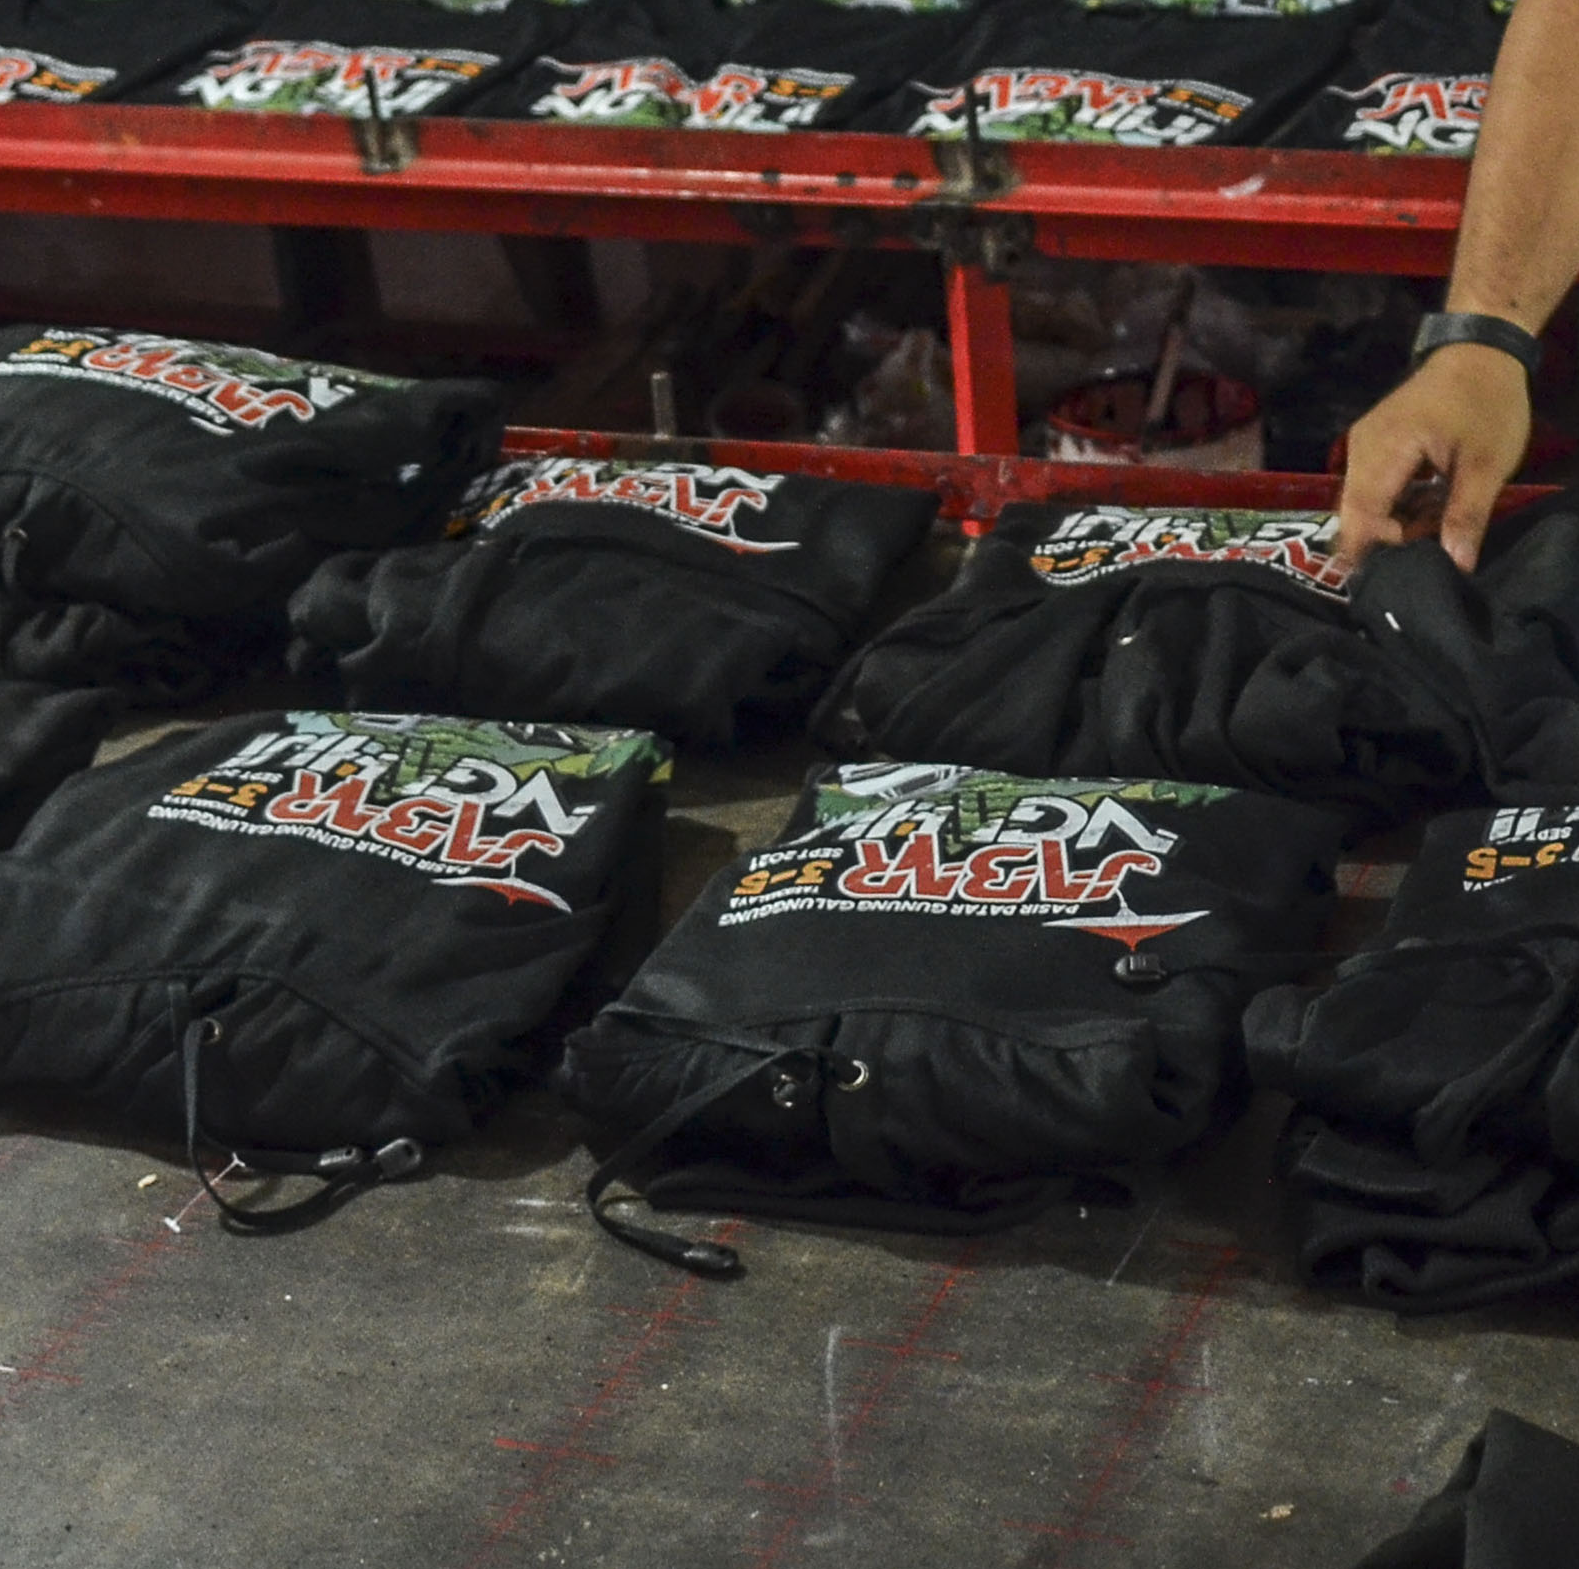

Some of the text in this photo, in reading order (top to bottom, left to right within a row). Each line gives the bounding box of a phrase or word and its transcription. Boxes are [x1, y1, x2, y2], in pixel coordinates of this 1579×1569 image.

[264, 770, 565, 870] JABAR
[273, 823, 356, 851] GUNUNG
[355, 839, 417, 867] DATAR
[416, 857, 472, 876] PASIR
[748, 847, 844, 872] SEPT 2021
[837, 832, 1162, 903] JABAR
[733, 859, 834, 895] 3-5
[717, 896, 1080, 928] PASIR DATAR GUNUNG GALUNGGUNG
